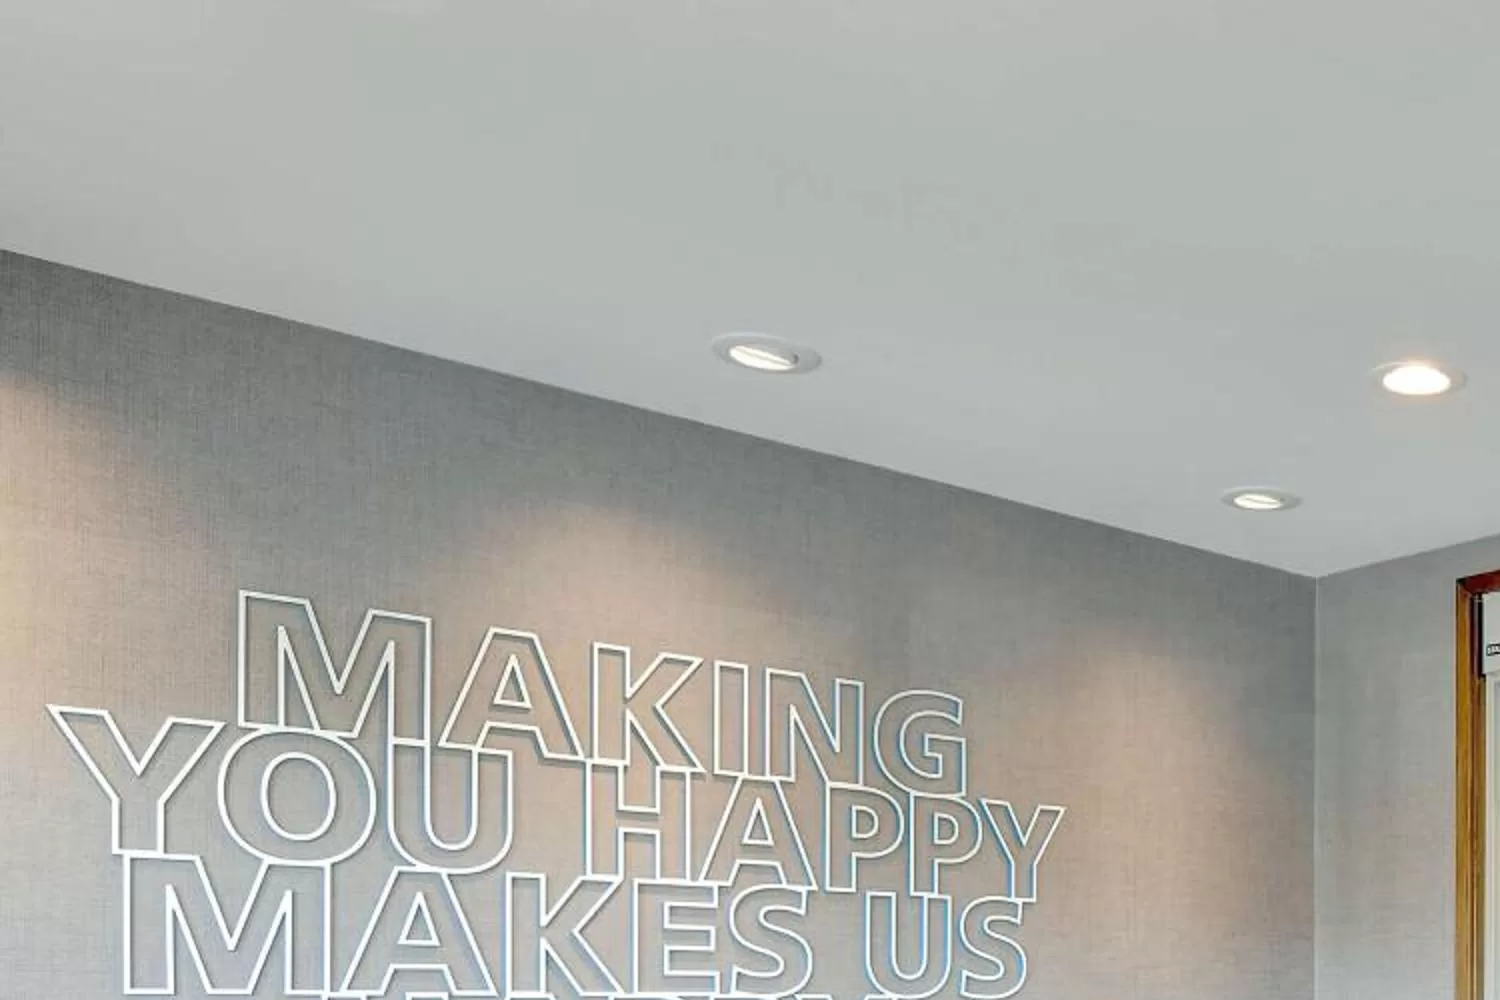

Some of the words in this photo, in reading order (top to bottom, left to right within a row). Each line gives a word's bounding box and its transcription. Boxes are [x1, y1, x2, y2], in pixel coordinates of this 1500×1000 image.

[238, 590, 967, 798] MAKING
[46, 703, 515, 873] YOU
[586, 758, 1066, 902] HAPPY
[123, 853, 814, 996] MAKES
[864, 890, 1028, 999] US
